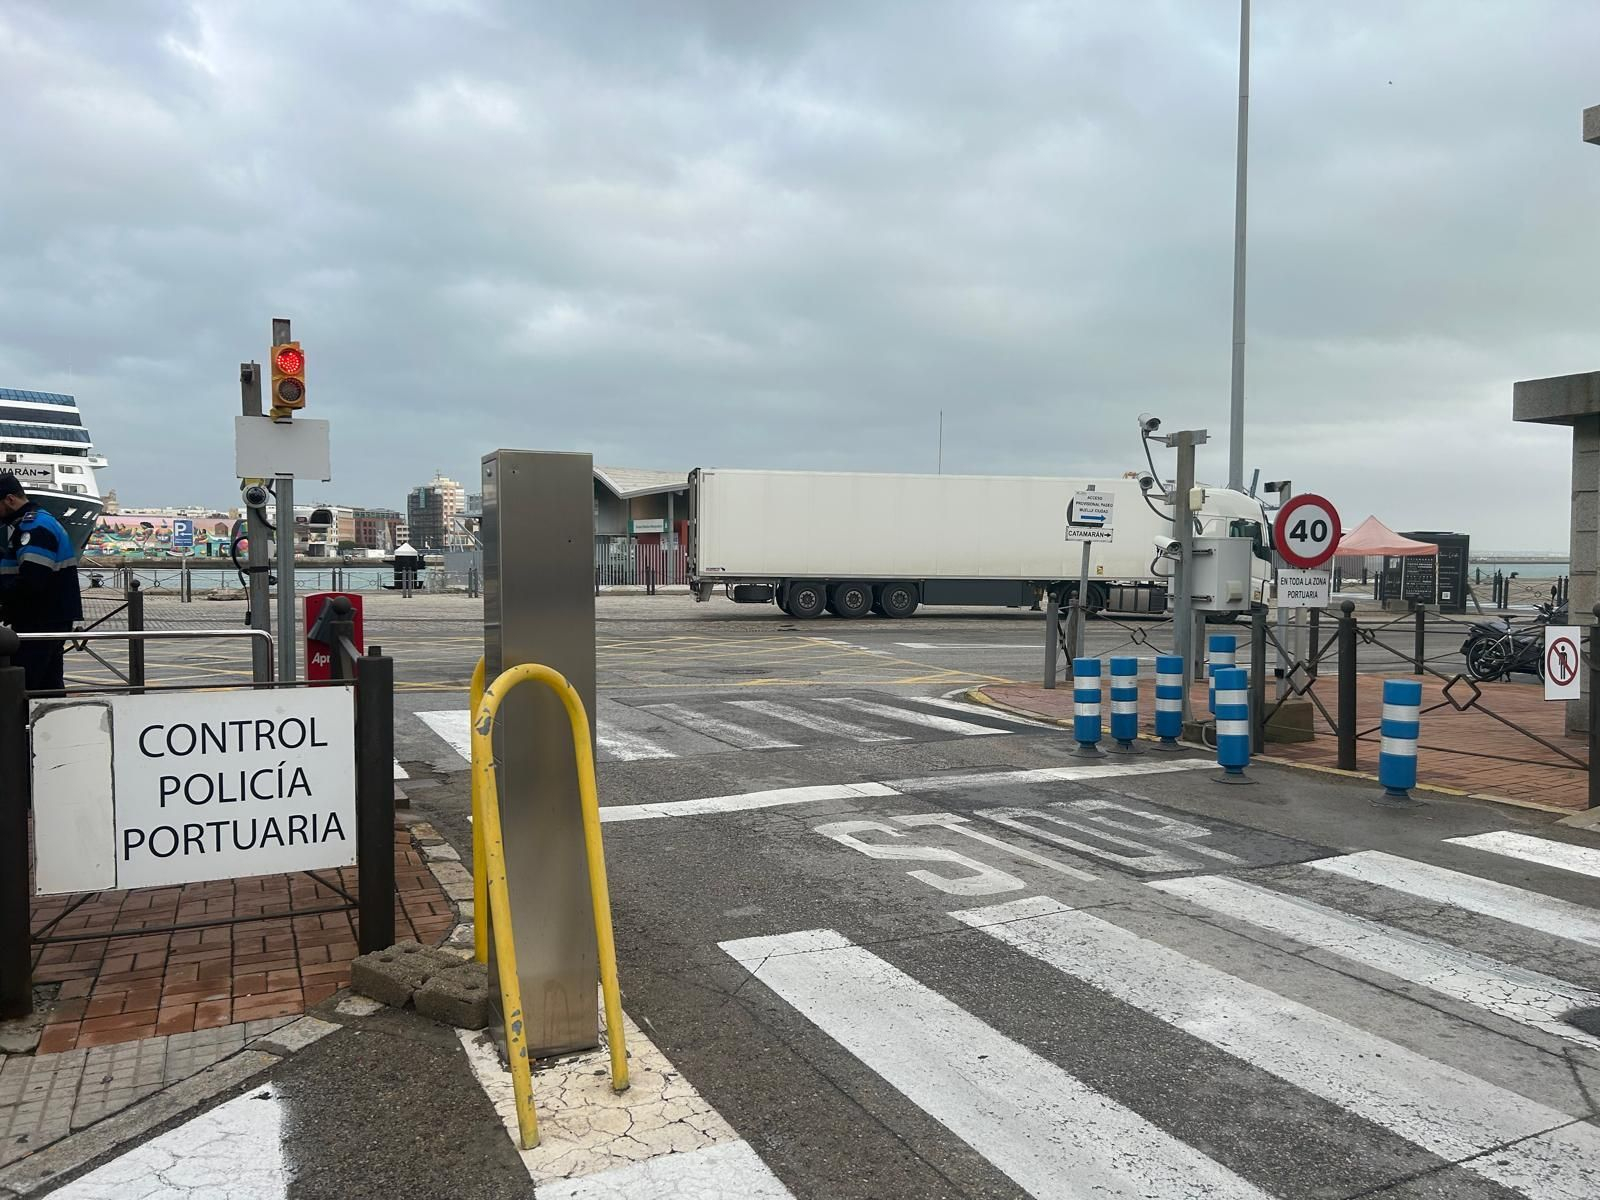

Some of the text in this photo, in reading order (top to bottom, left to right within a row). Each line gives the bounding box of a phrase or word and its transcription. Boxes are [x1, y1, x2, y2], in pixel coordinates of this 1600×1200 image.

[175, 522, 186, 536] P
[1289, 519, 1328, 542] 40
[1280, 577, 1326, 586] EN TODA LA ZONA
[1288, 590, 1318, 598] PORTUARIA
[138, 717, 329, 758] CONTROL
[159, 760, 313, 808] POLICÍA
[122, 811, 346, 861] PORTUARIA
[814, 799, 1250, 896] STOP
